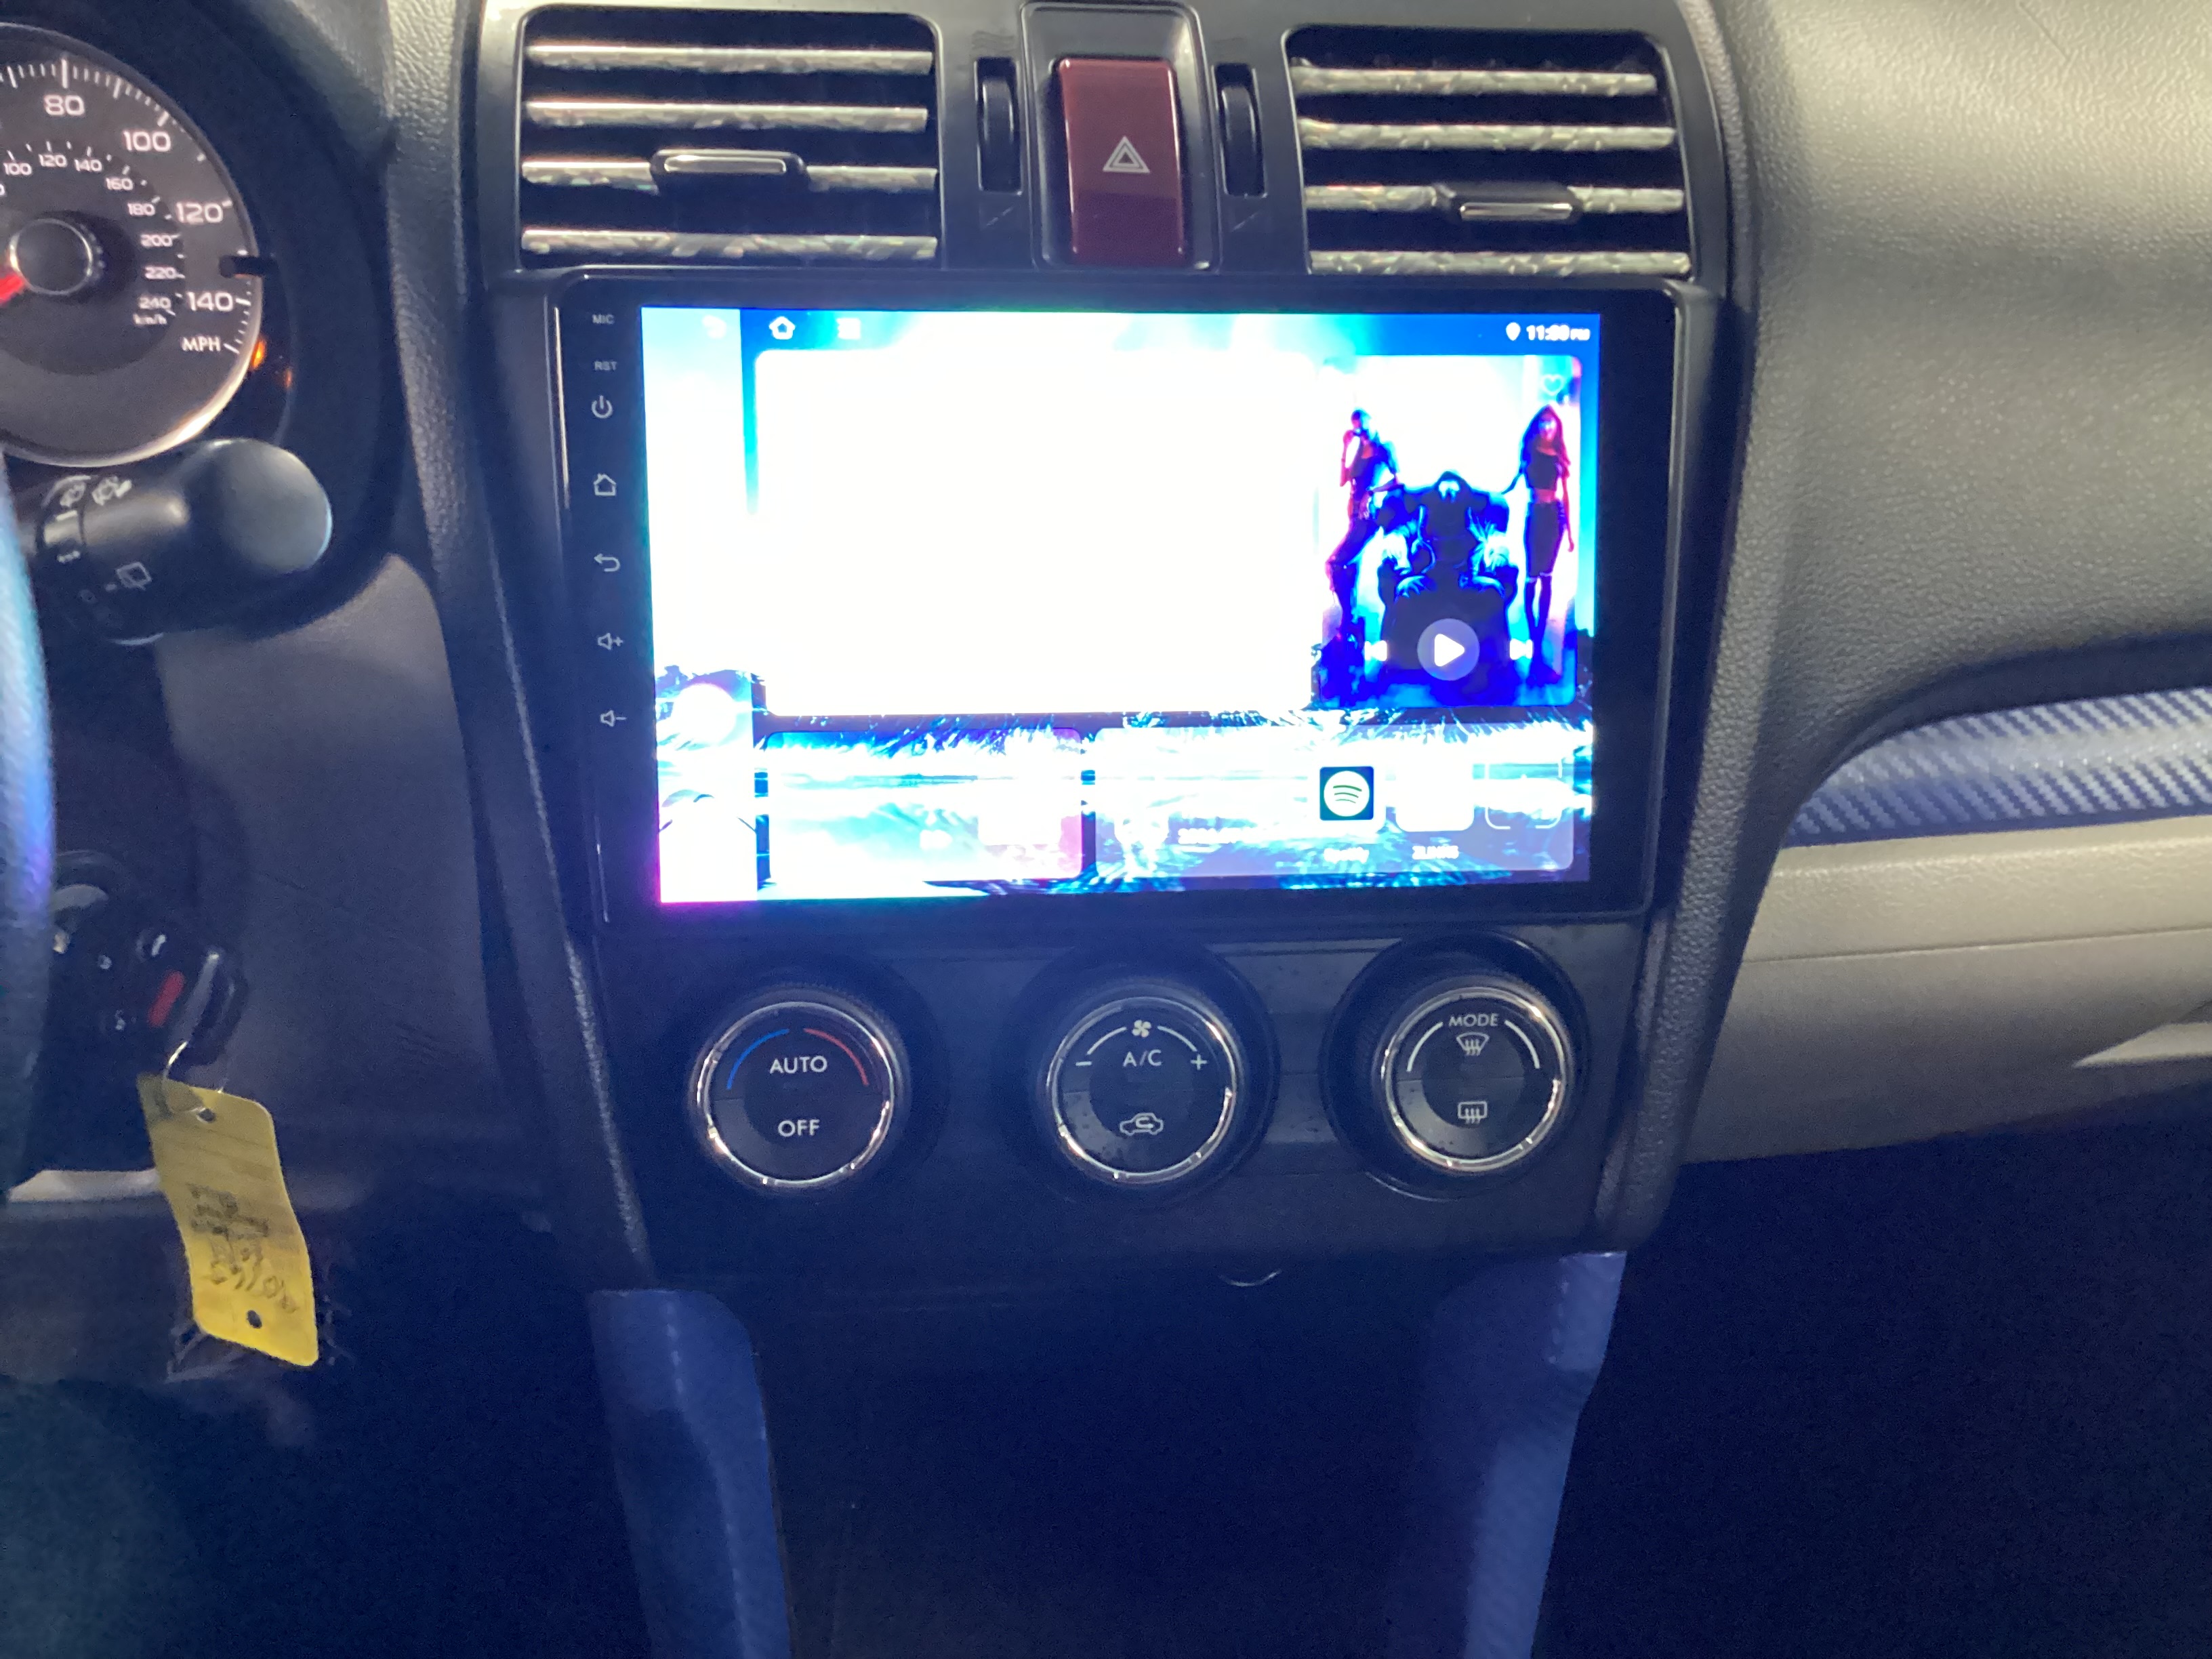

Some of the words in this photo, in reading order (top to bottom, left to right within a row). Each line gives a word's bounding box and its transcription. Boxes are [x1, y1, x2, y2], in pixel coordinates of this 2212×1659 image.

[43, 94, 85, 116] 80
[123, 130, 172, 152] 100
[38, 153, 67, 168] 120
[74, 158, 103, 173] 140
[3, 162, 33, 176] 100
[105, 177, 134, 191] 160
[127, 203, 155, 217] 180
[175, 202, 224, 225] 120
[140, 234, 173, 248] 200
[144, 267, 177, 279] 220
[138, 296, 172, 310] 240
[186, 291, 234, 312] 140
[592, 313, 615, 325] MIC
[181, 335, 221, 352] MPH
[594, 360, 617, 371] RST
[1448, 1012, 1500, 1027] MODE
[769, 1054, 828, 1075] AUTO
[1122, 1048, 1162, 1067] A/C
[777, 1119, 821, 1138] OFF
